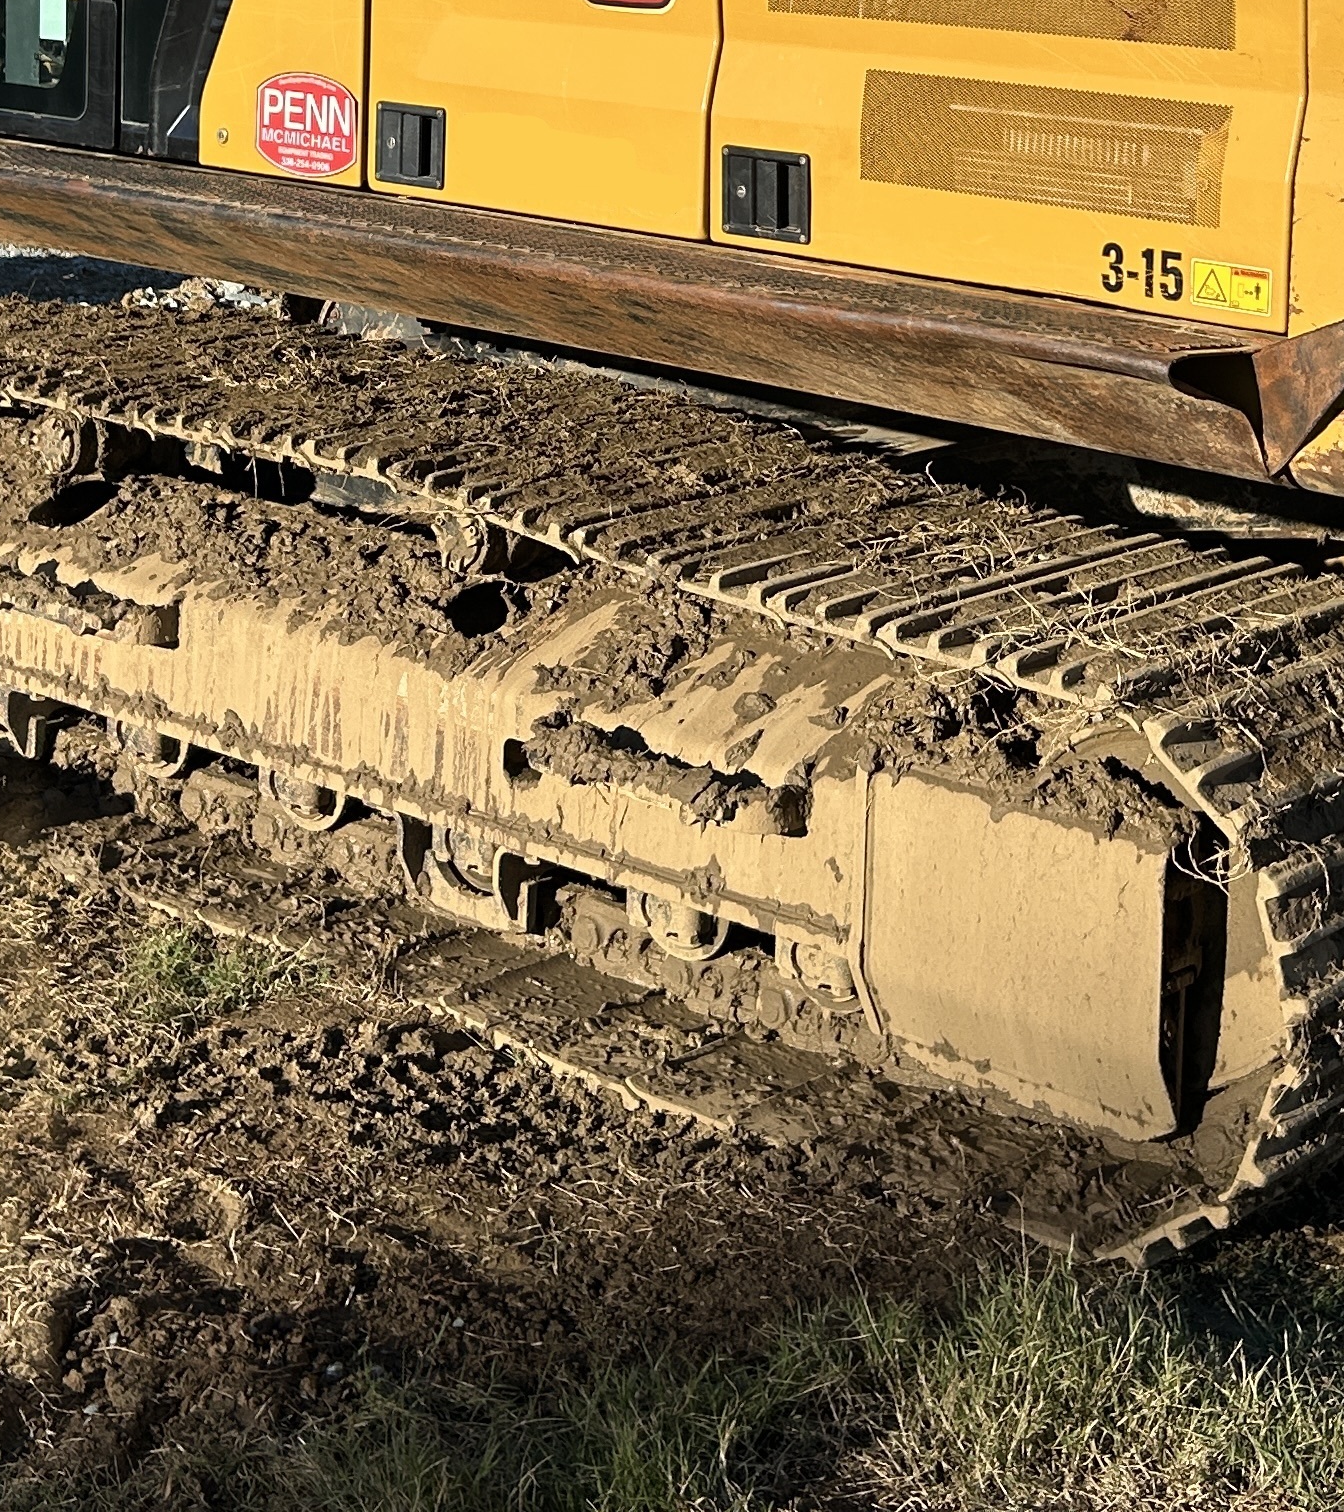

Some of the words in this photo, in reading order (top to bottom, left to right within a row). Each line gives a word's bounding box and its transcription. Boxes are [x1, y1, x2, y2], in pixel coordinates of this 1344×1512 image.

[262, 87, 351, 137] PENN
[261, 127, 351, 153] MCMICHAEL
[1101, 242, 1184, 302] 3-15
